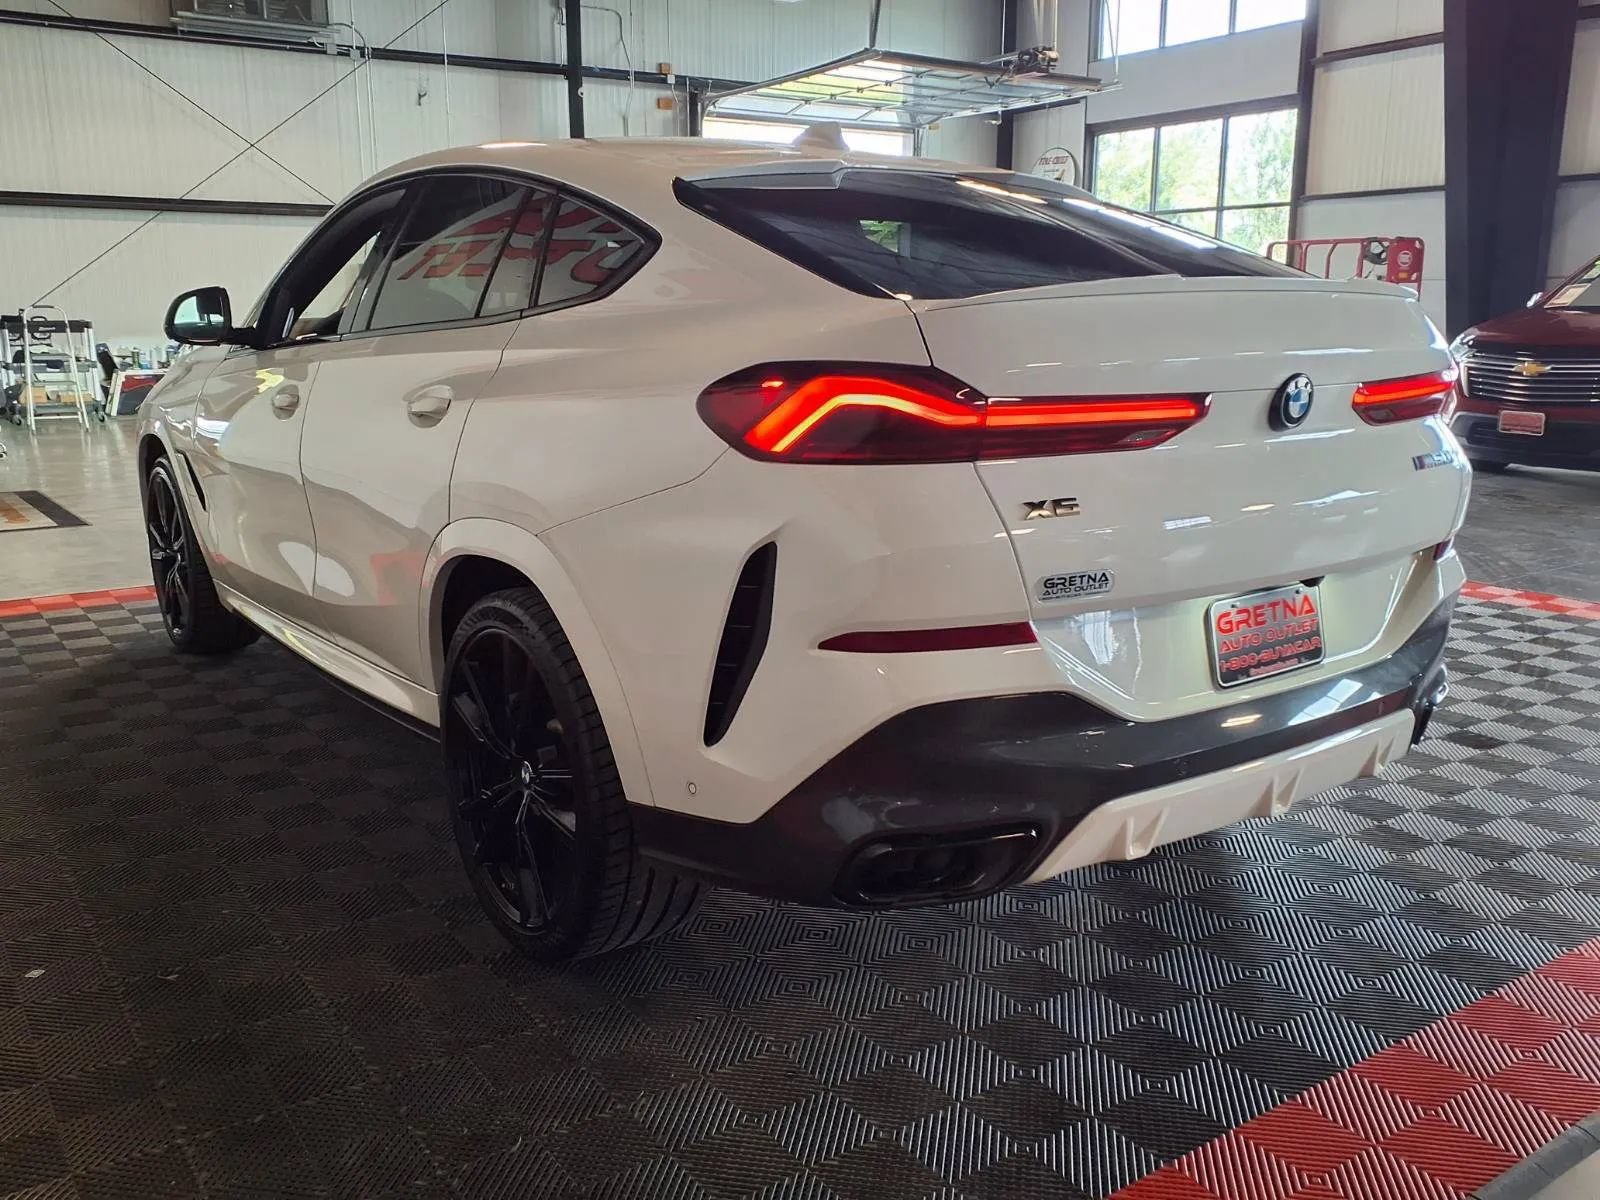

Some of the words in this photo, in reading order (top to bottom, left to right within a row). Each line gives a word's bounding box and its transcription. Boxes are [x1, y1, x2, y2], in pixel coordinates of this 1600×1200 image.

[1022, 497, 1081, 520] X6
[1042, 587, 1072, 596] AUTO
[1074, 582, 1109, 593] OUTLET
[1043, 572, 1110, 589] GRETNA
[1216, 594, 1317, 635] GRETNA
[1220, 632, 1263, 653] AUTO
[1264, 618, 1319, 642] OUTLET
